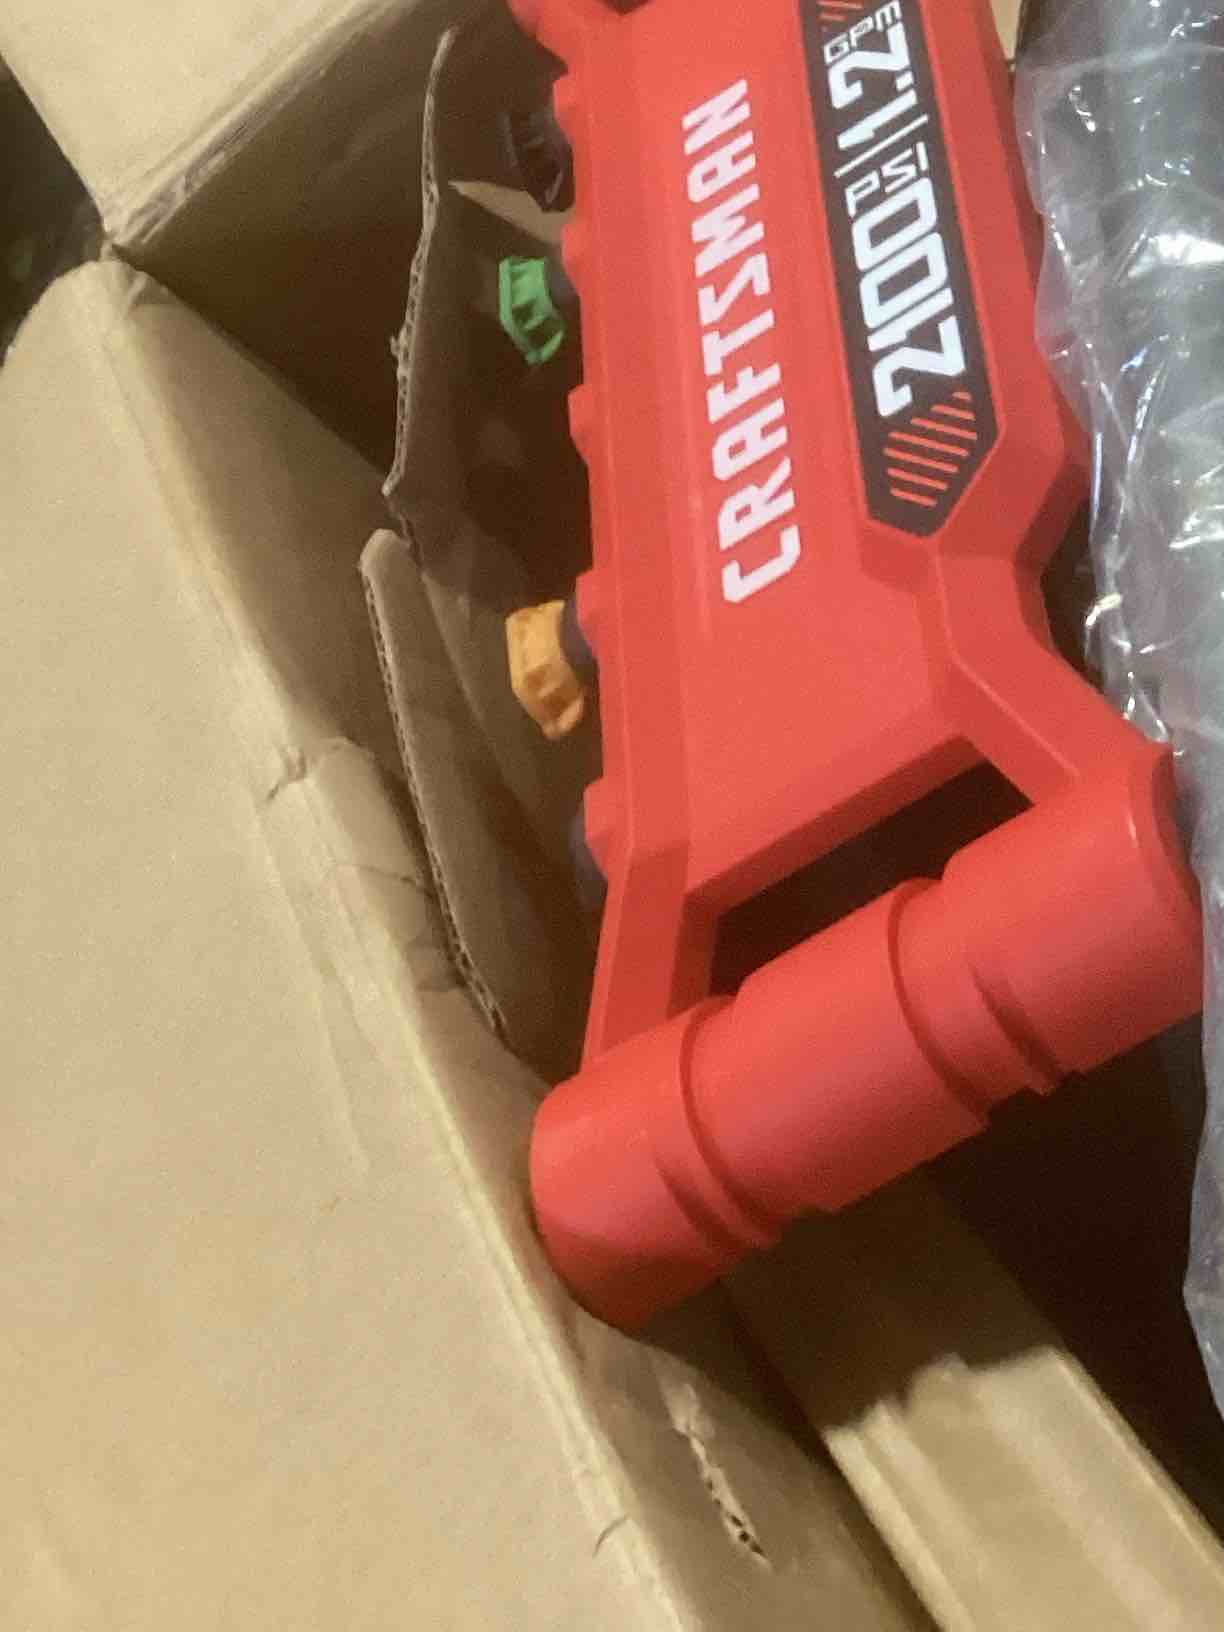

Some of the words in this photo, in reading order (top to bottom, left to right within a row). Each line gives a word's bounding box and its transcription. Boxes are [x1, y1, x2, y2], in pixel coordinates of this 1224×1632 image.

[827, 25, 919, 151] 1.2
[844, 143, 930, 216] PSI
[681, 79, 801, 604] CRAFTSMAN
[851, 176, 966, 417] 2100
